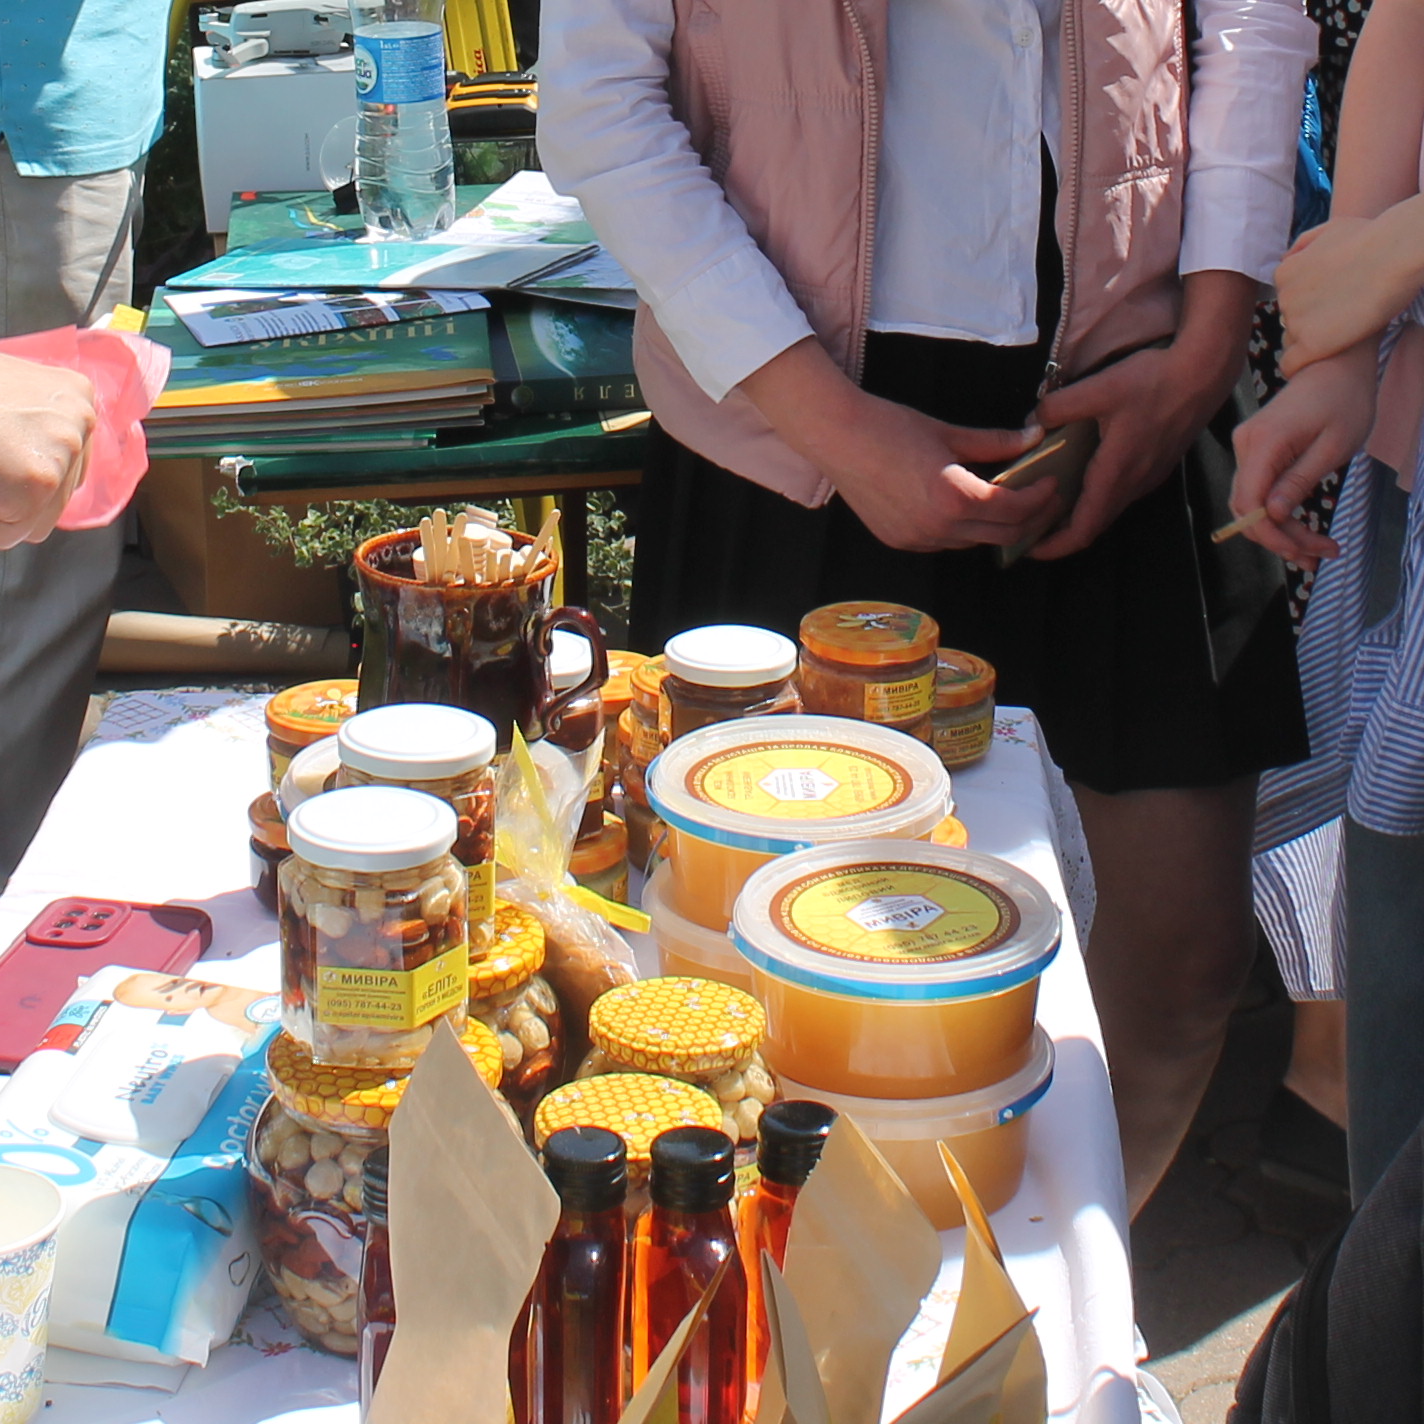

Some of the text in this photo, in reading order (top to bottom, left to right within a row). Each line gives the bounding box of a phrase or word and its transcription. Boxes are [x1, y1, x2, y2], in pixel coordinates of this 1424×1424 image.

[883, 681, 919, 694] МИВІРА
[864, 903, 939, 929] МИВІРА
[341, 973, 399, 988] МИВІРА
[422, 973, 458, 1000] «ЕЛІТ»
[327, 999, 403, 1012] (095) 787-44-23
